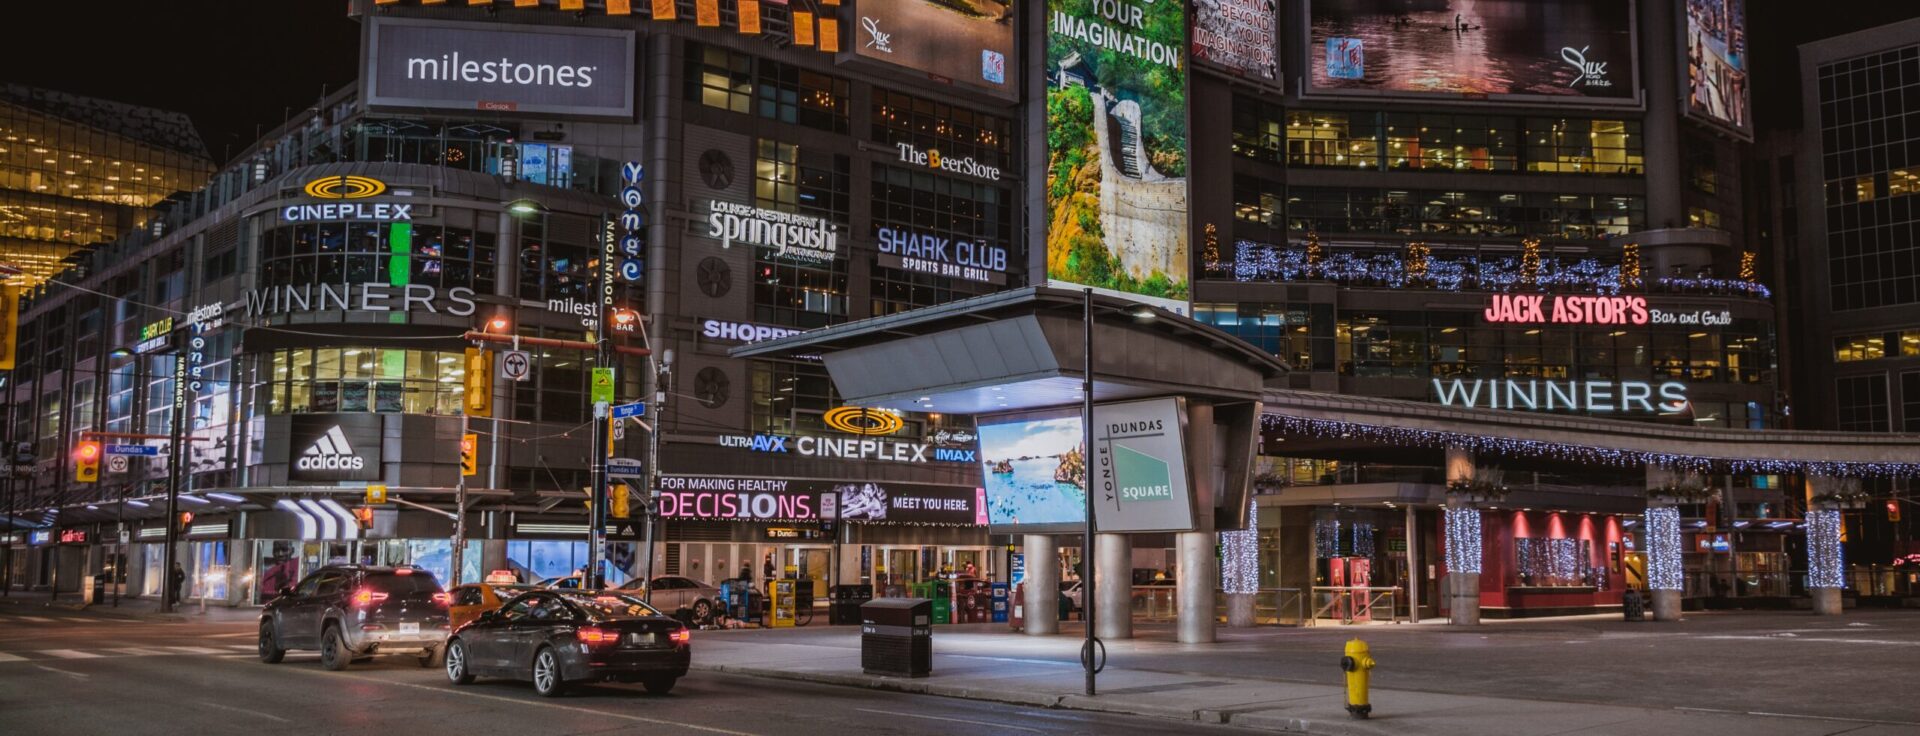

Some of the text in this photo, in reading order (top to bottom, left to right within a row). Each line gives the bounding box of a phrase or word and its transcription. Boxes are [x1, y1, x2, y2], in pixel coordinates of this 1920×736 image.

[1092, 0, 1143, 30] YOUR
[1221, 3, 1270, 32] BEYOND
[1054, 11, 1178, 69] IMAGINATION
[1193, 26, 1272, 66] IMAGINATION
[1237, 25, 1271, 49] YOUR
[407, 51, 596, 88] milestones
[897, 142, 927, 167] The
[963, 157, 1000, 181] Store
[285, 203, 412, 221] CINEPLEX
[604, 221, 616, 305] DOWNTOWN
[878, 228, 1007, 272] SHARK CLUB
[902, 257, 989, 283] SPORTS BAR GRILL
[246, 281, 476, 318] WINNERS
[1485, 295, 1732, 325] JACK ASTOR'S Bar and Grill
[616, 323, 634, 332] BAR
[176, 356, 185, 409] DOWNTOWN
[1432, 378, 1688, 412] WINNERS
[1112, 420, 1163, 434] DUNDAS
[115, 445, 143, 453] Dundas
[299, 453, 364, 470] adidas
[797, 436, 928, 463] CINEPLEX
[935, 448, 976, 462] IMAX
[660, 478, 788, 492] FOR MAKING HEALTHY
[1100, 446, 1113, 502] YONGE
[893, 497, 969, 511] MEET YOU HERE.
[1123, 485, 1169, 499] SQUARE
